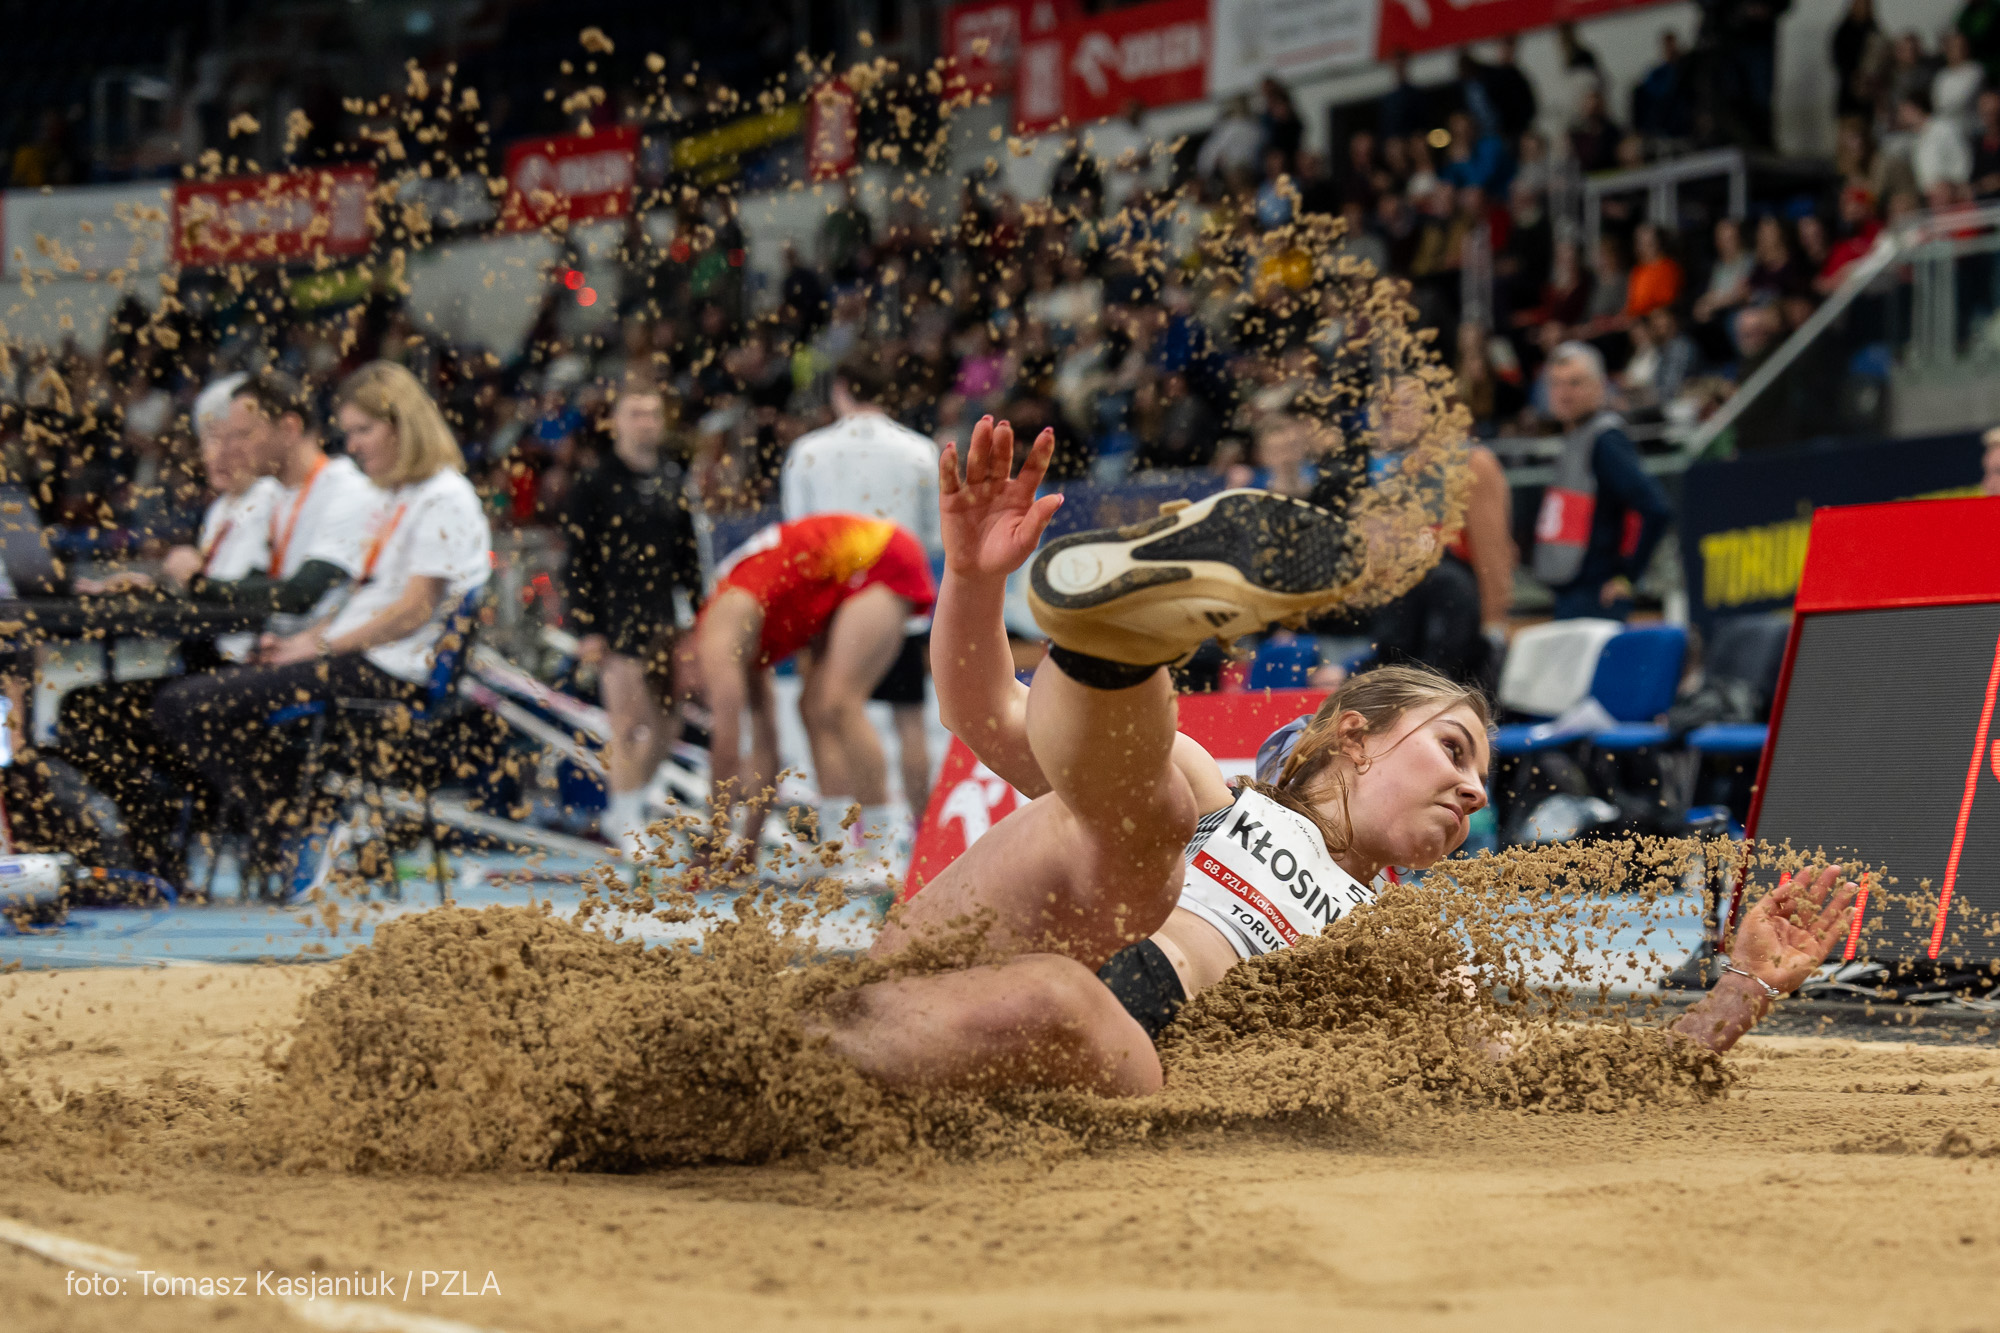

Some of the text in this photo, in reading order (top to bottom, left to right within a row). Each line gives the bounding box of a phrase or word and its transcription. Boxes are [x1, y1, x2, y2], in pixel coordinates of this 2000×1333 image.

[1202, 859, 1220, 877] 68.
[1221, 872, 1250, 896] PZLA
[1248, 892, 1286, 930] Halowe
